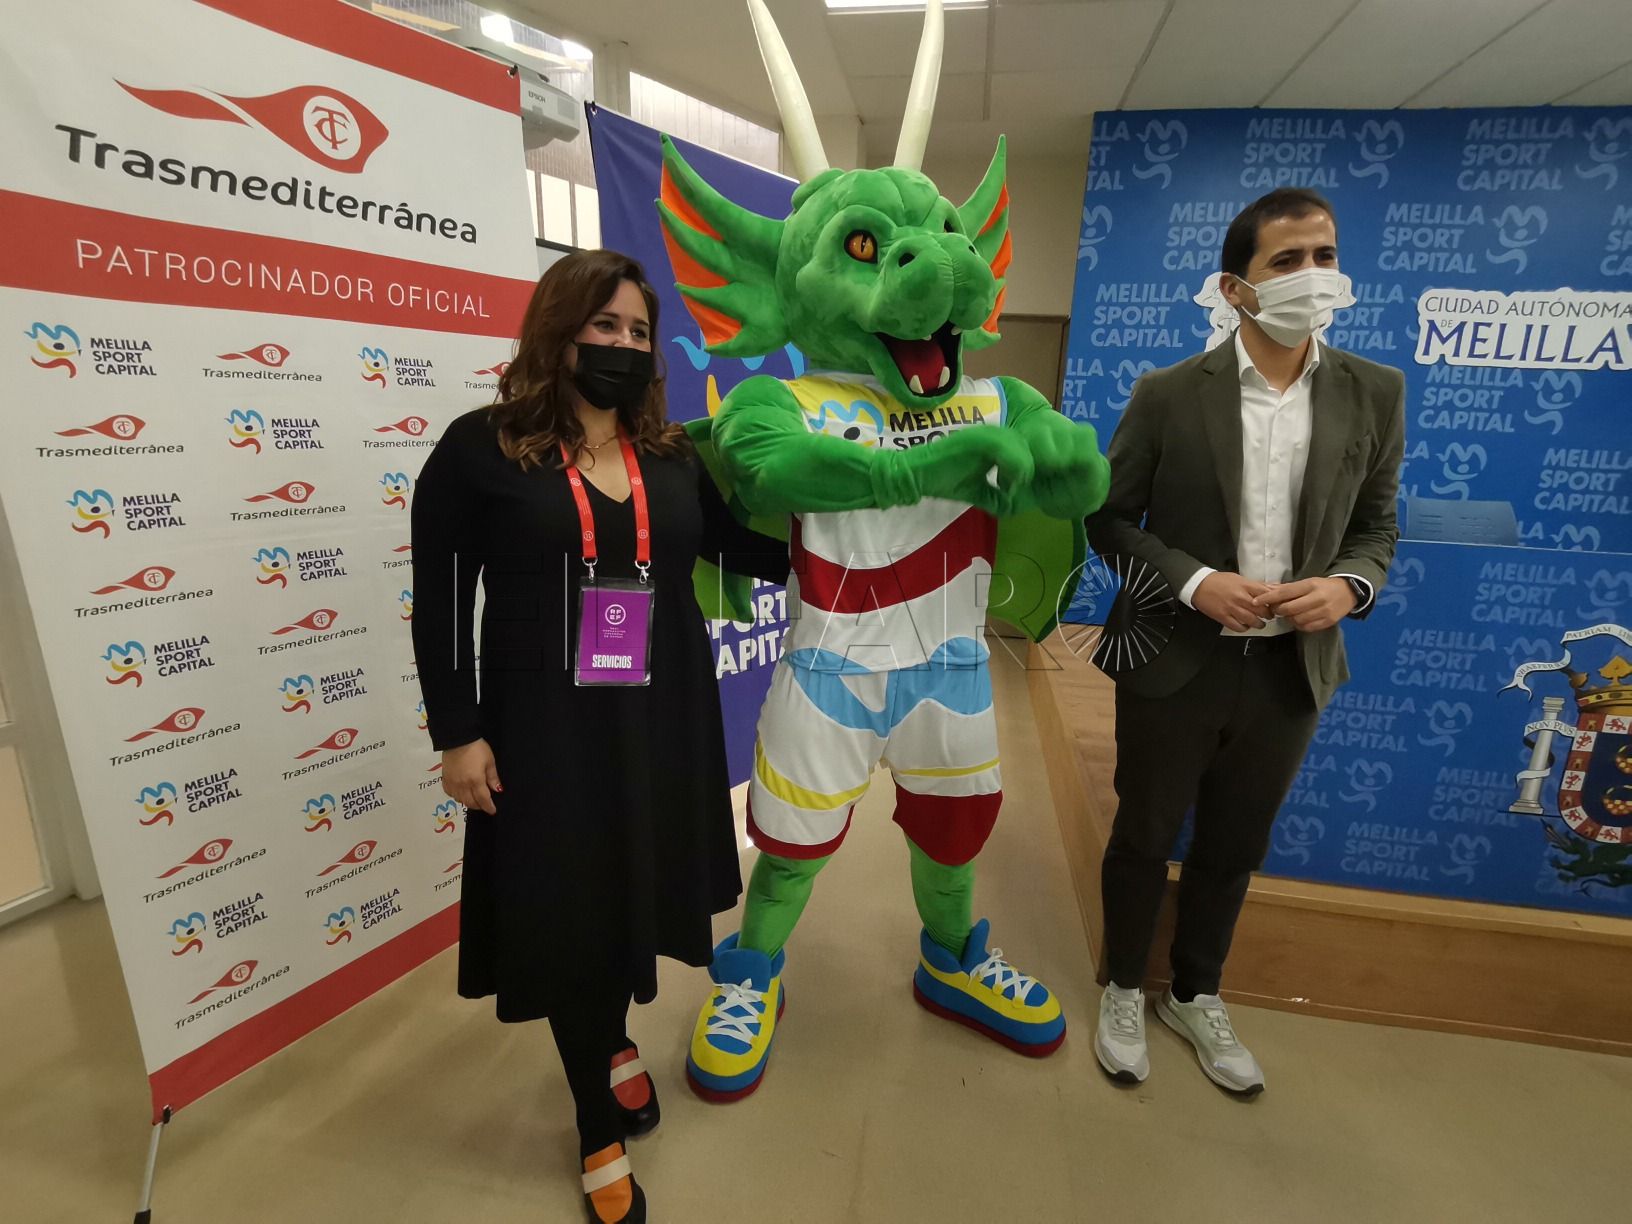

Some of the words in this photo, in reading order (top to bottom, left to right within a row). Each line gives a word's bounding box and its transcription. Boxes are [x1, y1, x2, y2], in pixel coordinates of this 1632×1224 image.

[1246, 117, 1346, 140] MELILLA
[1465, 117, 1574, 140] MELILLA
[1243, 142, 1326, 164] SPORT
[1461, 142, 1553, 166] SPORT
[55, 123, 478, 245] Trasmediterránea
[1239, 167, 1340, 189] CAPITAL
[1456, 170, 1564, 191] CAPITAL
[1385, 202, 1485, 225] MELILLA
[1165, 226, 1228, 248] SPO
[1381, 227, 1464, 249] SPORT
[1162, 250, 1220, 271] CAPI
[1377, 250, 1477, 274] CAPITAL
[75, 237, 375, 304] PATROCINADOR
[387, 282, 490, 318] OFICIAL
[1095, 283, 1189, 303] MELILLA
[1356, 283, 1404, 304] ILLA
[1092, 306, 1170, 326] SPORT
[1424, 296, 1499, 315] CIUDAD
[1334, 307, 1384, 327] ORT
[1440, 319, 1454, 328] DE
[90, 337, 153, 351] MELILLA
[1090, 328, 1183, 348] CAPITAL
[1326, 330, 1397, 350] PITAL
[1422, 319, 1624, 365] MELILLA
[92, 351, 143, 364] SPORT
[394, 357, 433, 368] MELILLA
[95, 364, 157, 377] CAPITAL
[396, 367, 427, 377] SPORT
[1425, 364, 1524, 388] MELILLA
[397, 377, 436, 387] CAPITAL
[1421, 387, 1504, 410] SPORT
[271, 417, 320, 429] MELILLA
[889, 406, 986, 433] MELILLA
[1417, 409, 1515, 433] CAPITAL
[273, 428, 313, 439] SPORT
[275, 439, 324, 450] CAPITAL
[1538, 470, 1622, 492] SPORT
[122, 493, 181, 507] MELILLA
[1534, 492, 1632, 515] CAPITAL
[124, 506, 172, 519] SPORT
[127, 516, 186, 531] CAPITAL
[296, 547, 344, 562] MELILLA
[298, 558, 337, 571] SPORT
[300, 567, 347, 582] CAPITAL
[1479, 561, 1577, 585] MELILLA
[1475, 583, 1557, 606] SPORT
[1471, 604, 1566, 627] CAPITAL
[153, 635, 210, 655] MELILLA
[1399, 628, 1496, 652] MELILLA
[156, 648, 201, 666] SPORT
[592, 654, 632, 669] SERVICIOS
[716, 627, 790, 680] APIT
[1395, 648, 1478, 671] SPORT
[158, 656, 215, 677] CAPITAL
[320, 667, 364, 686] MELILLA
[321, 678, 358, 695] SPORT
[1390, 669, 1487, 693] CAPITAL
[323, 685, 368, 705] CAPITAL
[184, 768, 238, 793] MELILLA
[1435, 766, 1514, 789] MELILL
[186, 780, 230, 803] SPORT
[188, 788, 243, 813] CAPITAL
[341, 780, 383, 803] MELILLA
[342, 792, 377, 812] SPORT
[343, 798, 386, 820] CAPITAL
[212, 892, 264, 921] MELILLA
[360, 888, 400, 913] MELILLA
[361, 899, 394, 922] SPORT
[214, 904, 257, 929] SPORT
[216, 911, 268, 939] CAPITAL
[362, 904, 403, 930] CAPITAL
